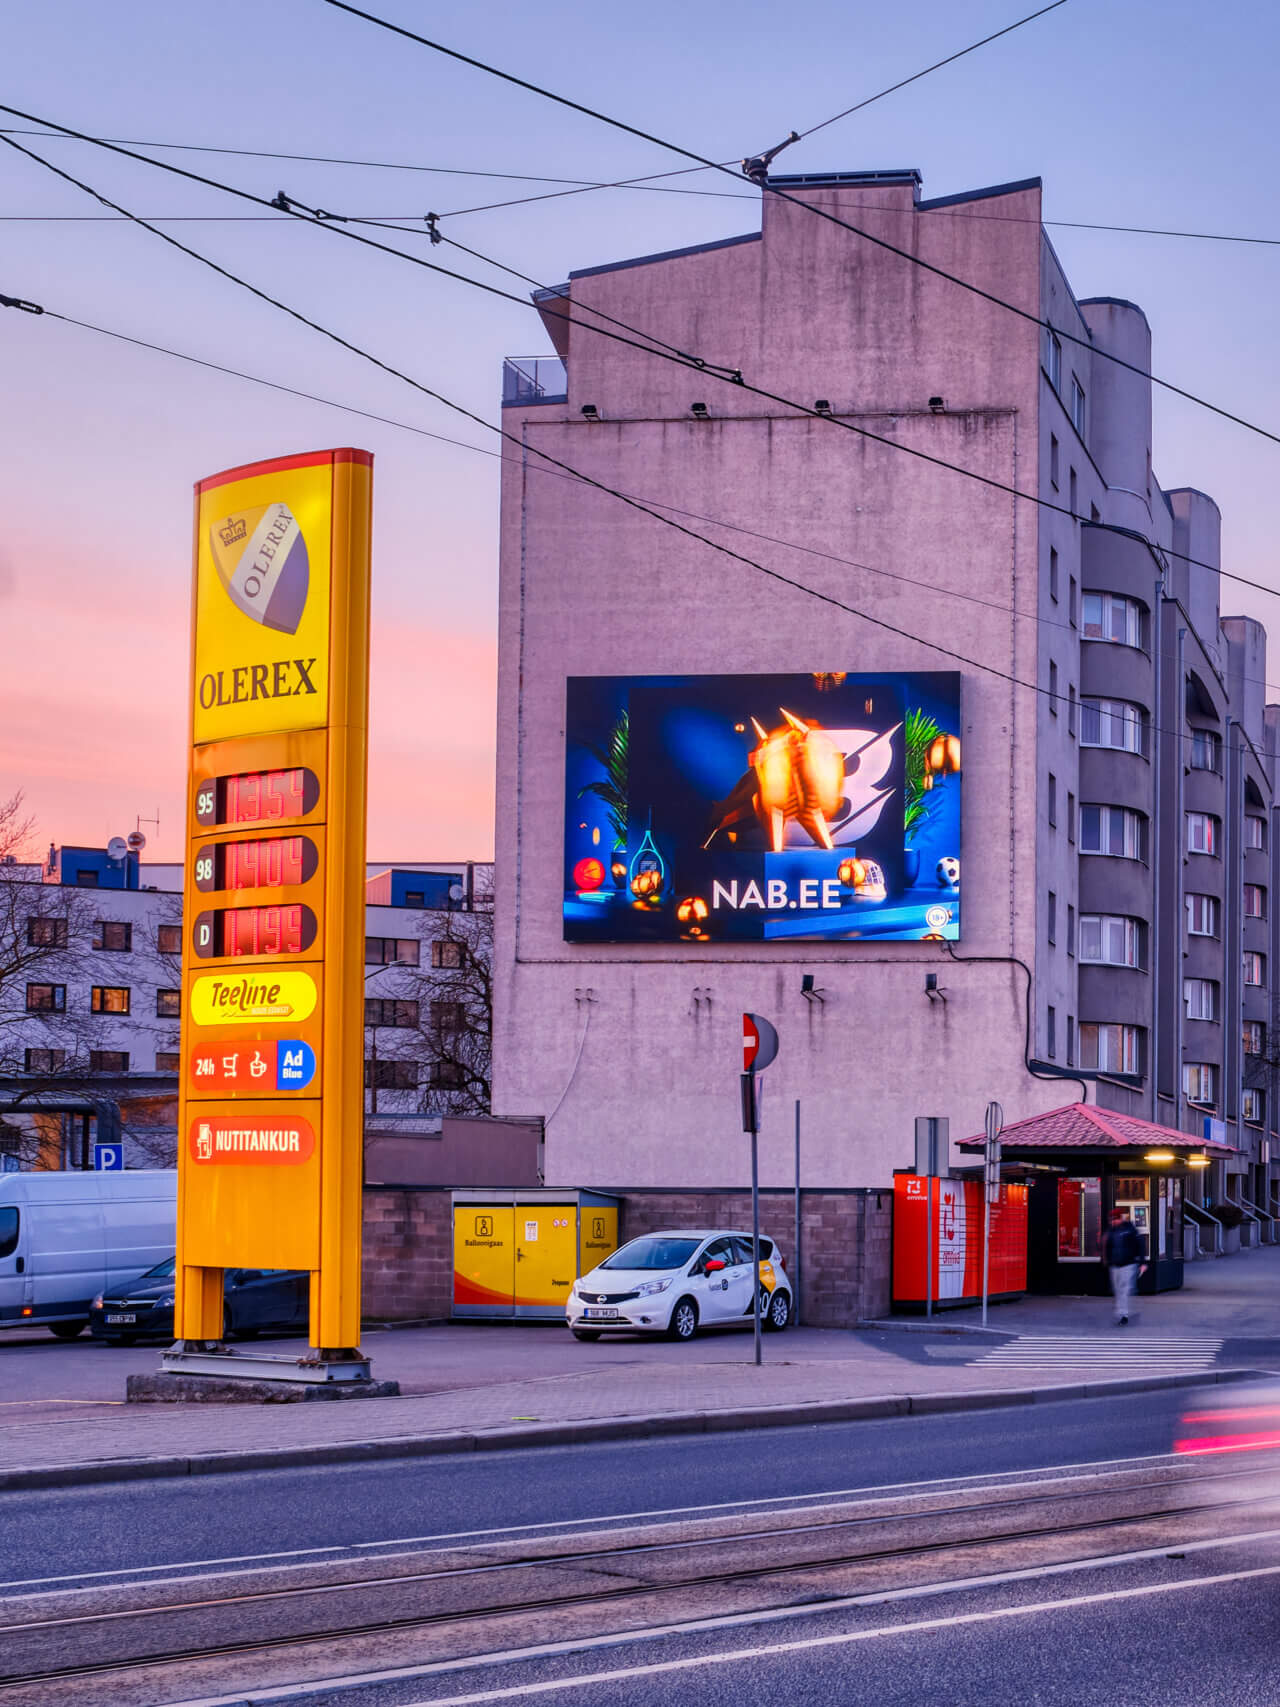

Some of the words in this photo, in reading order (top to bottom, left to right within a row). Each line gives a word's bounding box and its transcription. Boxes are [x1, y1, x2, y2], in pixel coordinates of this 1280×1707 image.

[243, 508, 294, 599] OLEREX
[199, 658, 318, 710] OLEREX
[197, 792, 214, 815] 95
[195, 858, 213, 881] 98
[713, 880, 842, 908] NAB.EE
[199, 924, 211, 947] D
[211, 978, 281, 1012] Teeline
[195, 1058, 216, 1076] 24h
[282, 1050, 304, 1067] Ad
[282, 1066, 304, 1079] Blue
[215, 1128, 300, 1153] NUTITANKUR
[101, 1149, 116, 1170] P
